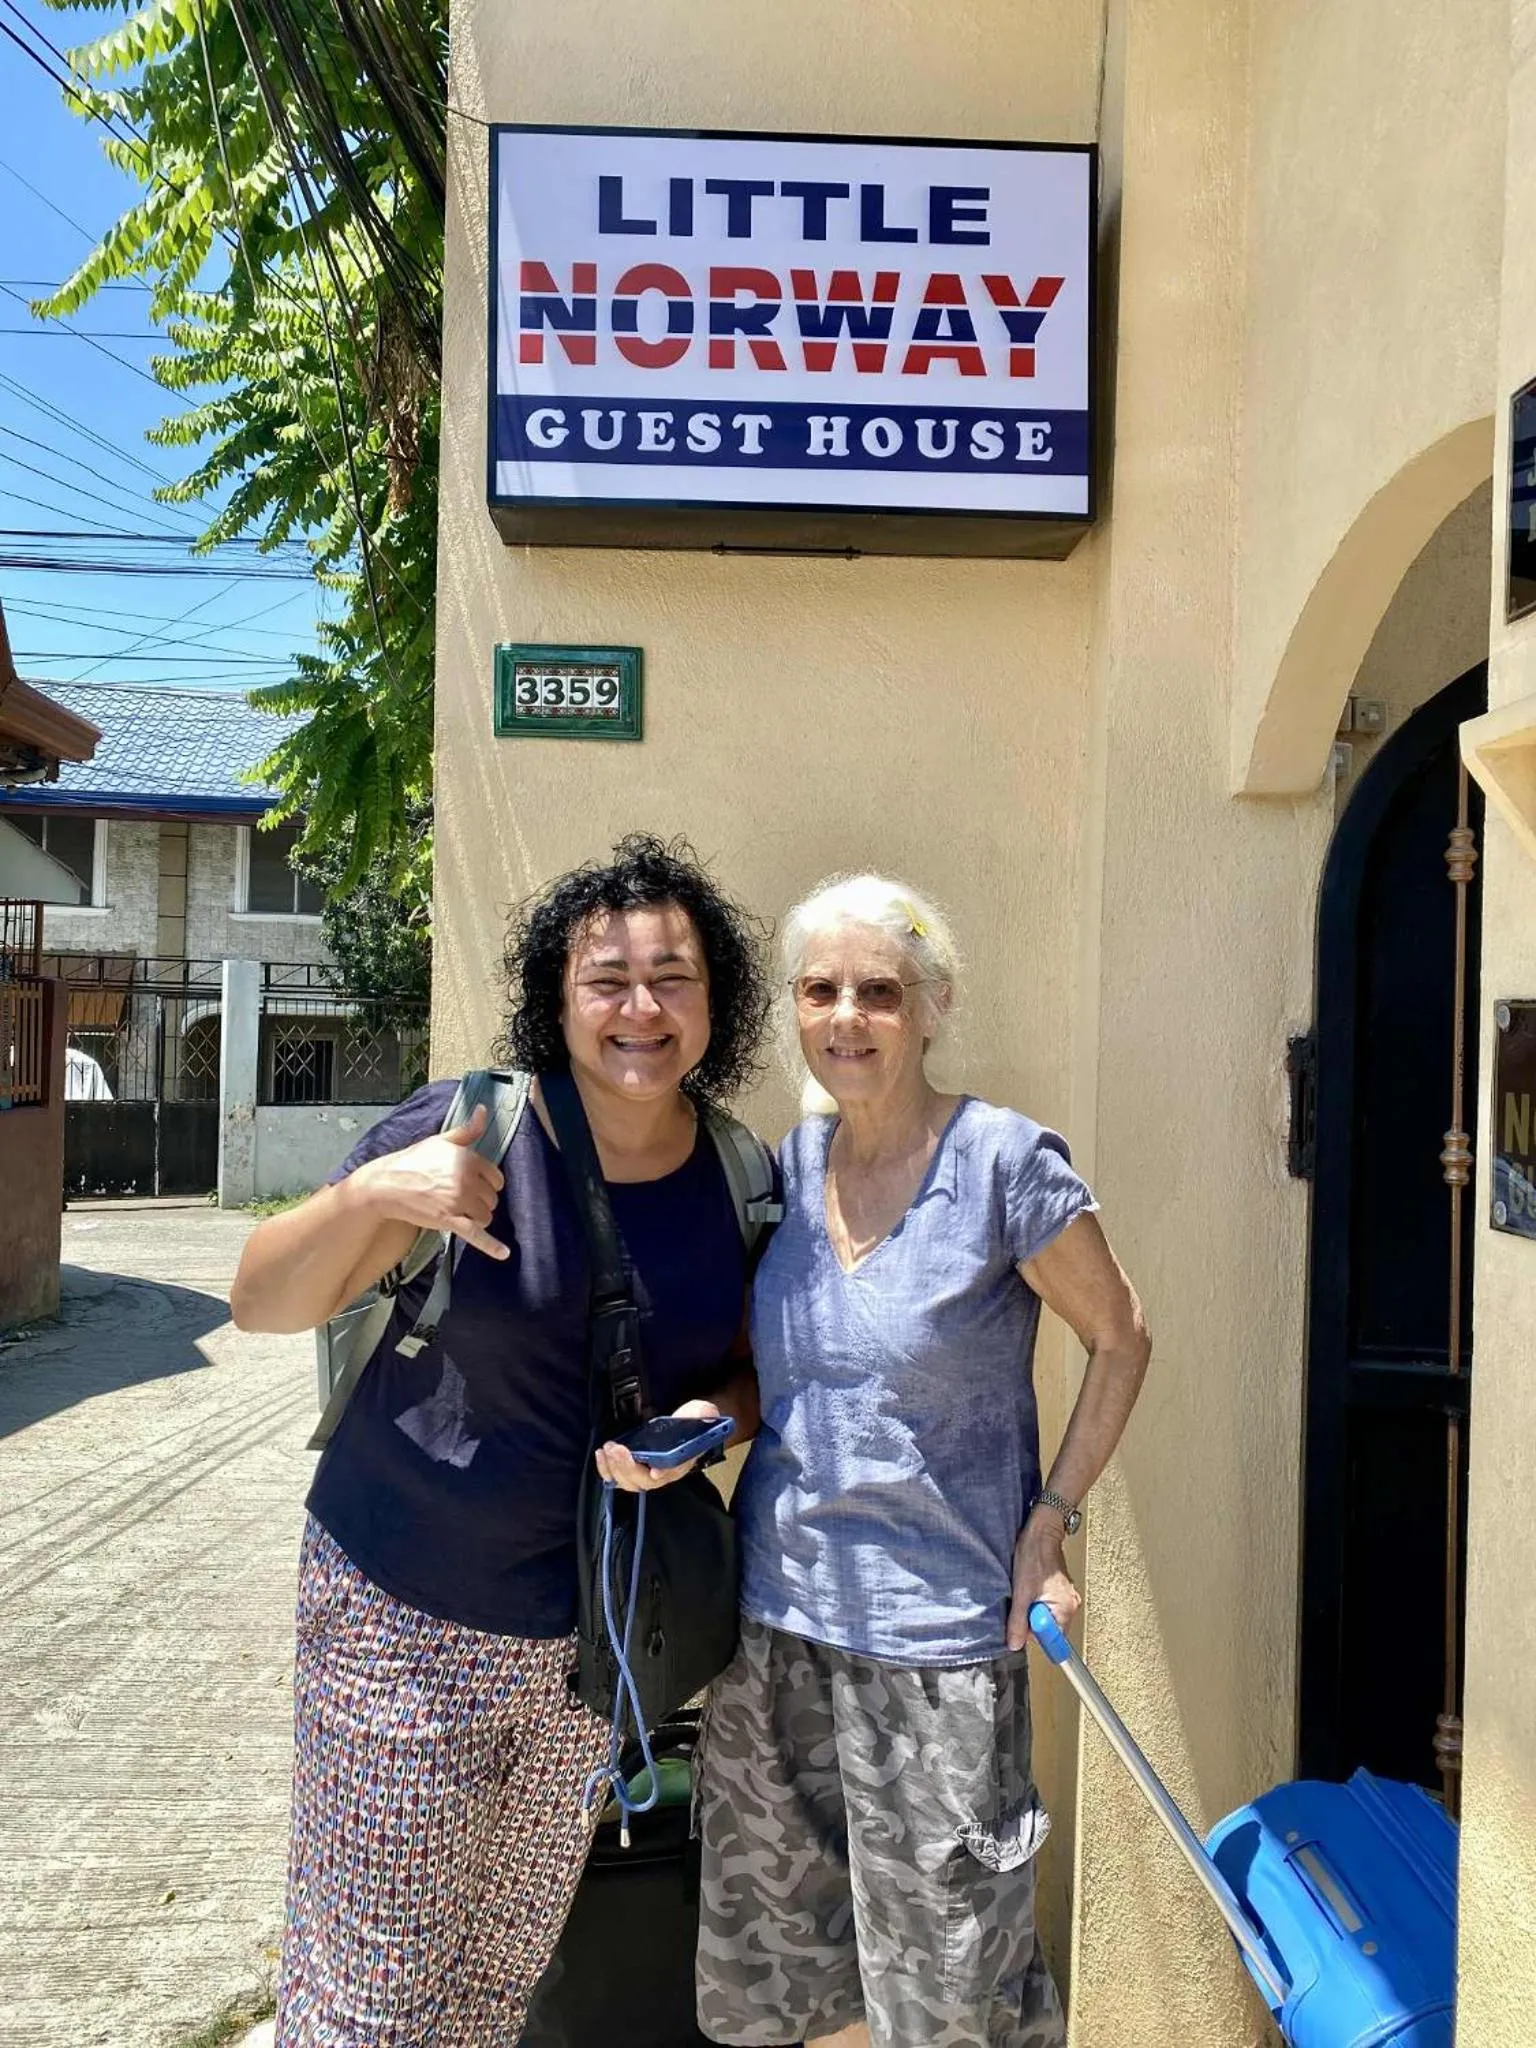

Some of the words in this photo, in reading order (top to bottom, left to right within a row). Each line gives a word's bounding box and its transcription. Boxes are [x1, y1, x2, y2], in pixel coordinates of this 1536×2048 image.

[598, 175, 991, 246] LITTLE
[519, 260, 1066, 378] NORWAY
[525, 408, 773, 455] GUEST
[807, 415, 1054, 463] HOUSE
[517, 676, 618, 706] 3359
